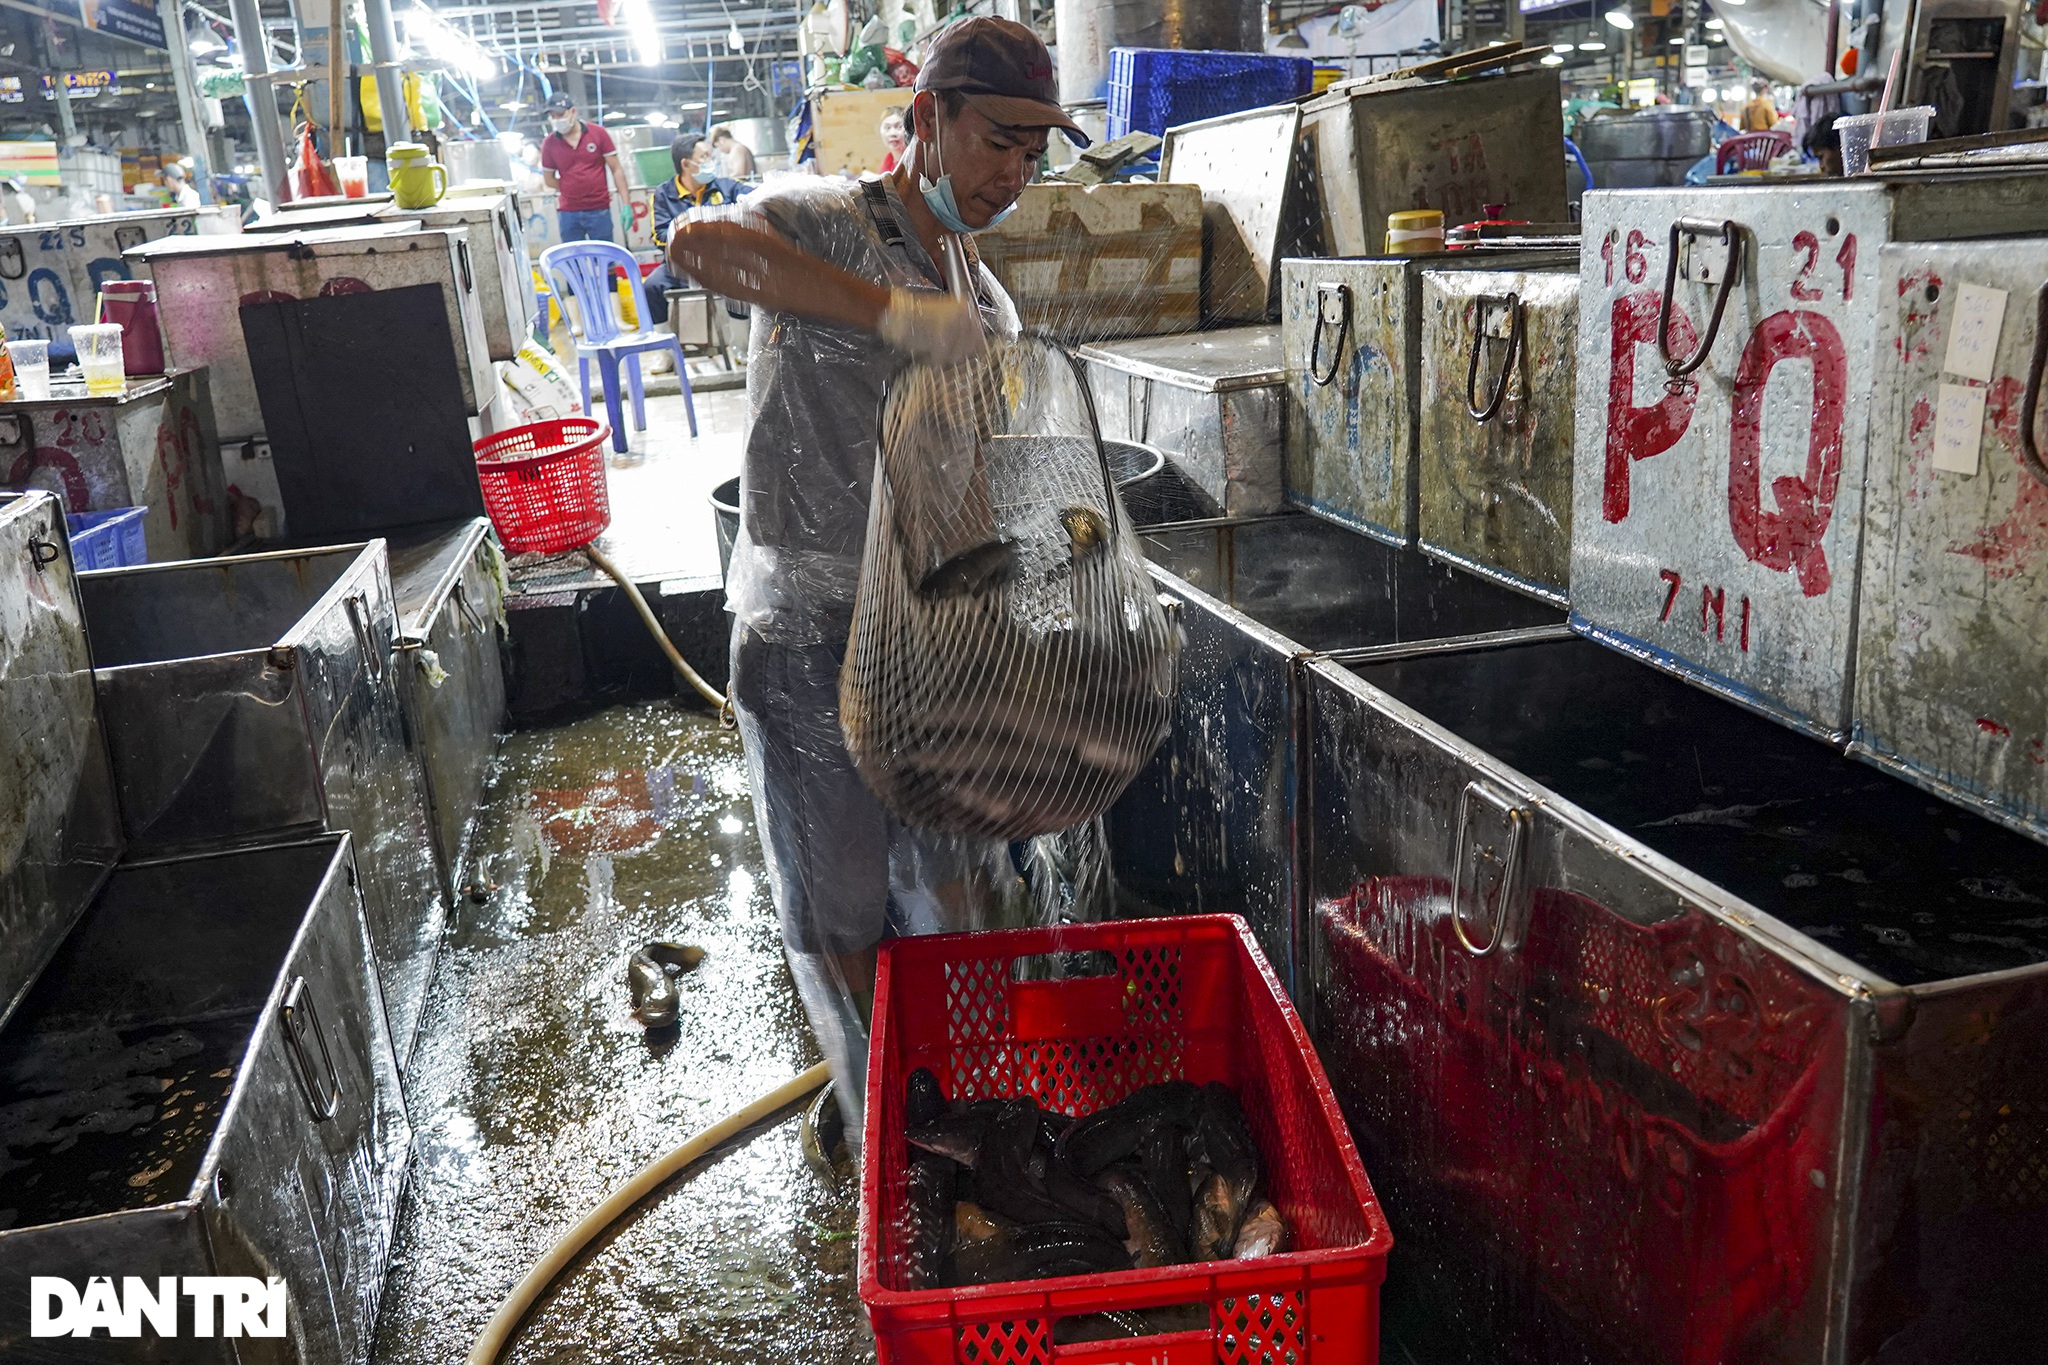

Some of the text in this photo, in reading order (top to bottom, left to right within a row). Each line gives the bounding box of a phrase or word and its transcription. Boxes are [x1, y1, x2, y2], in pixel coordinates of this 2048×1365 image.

[1600, 229, 1656, 287] 16
[1791, 230, 1858, 301] 21
[1603, 290, 1848, 597] PQ
